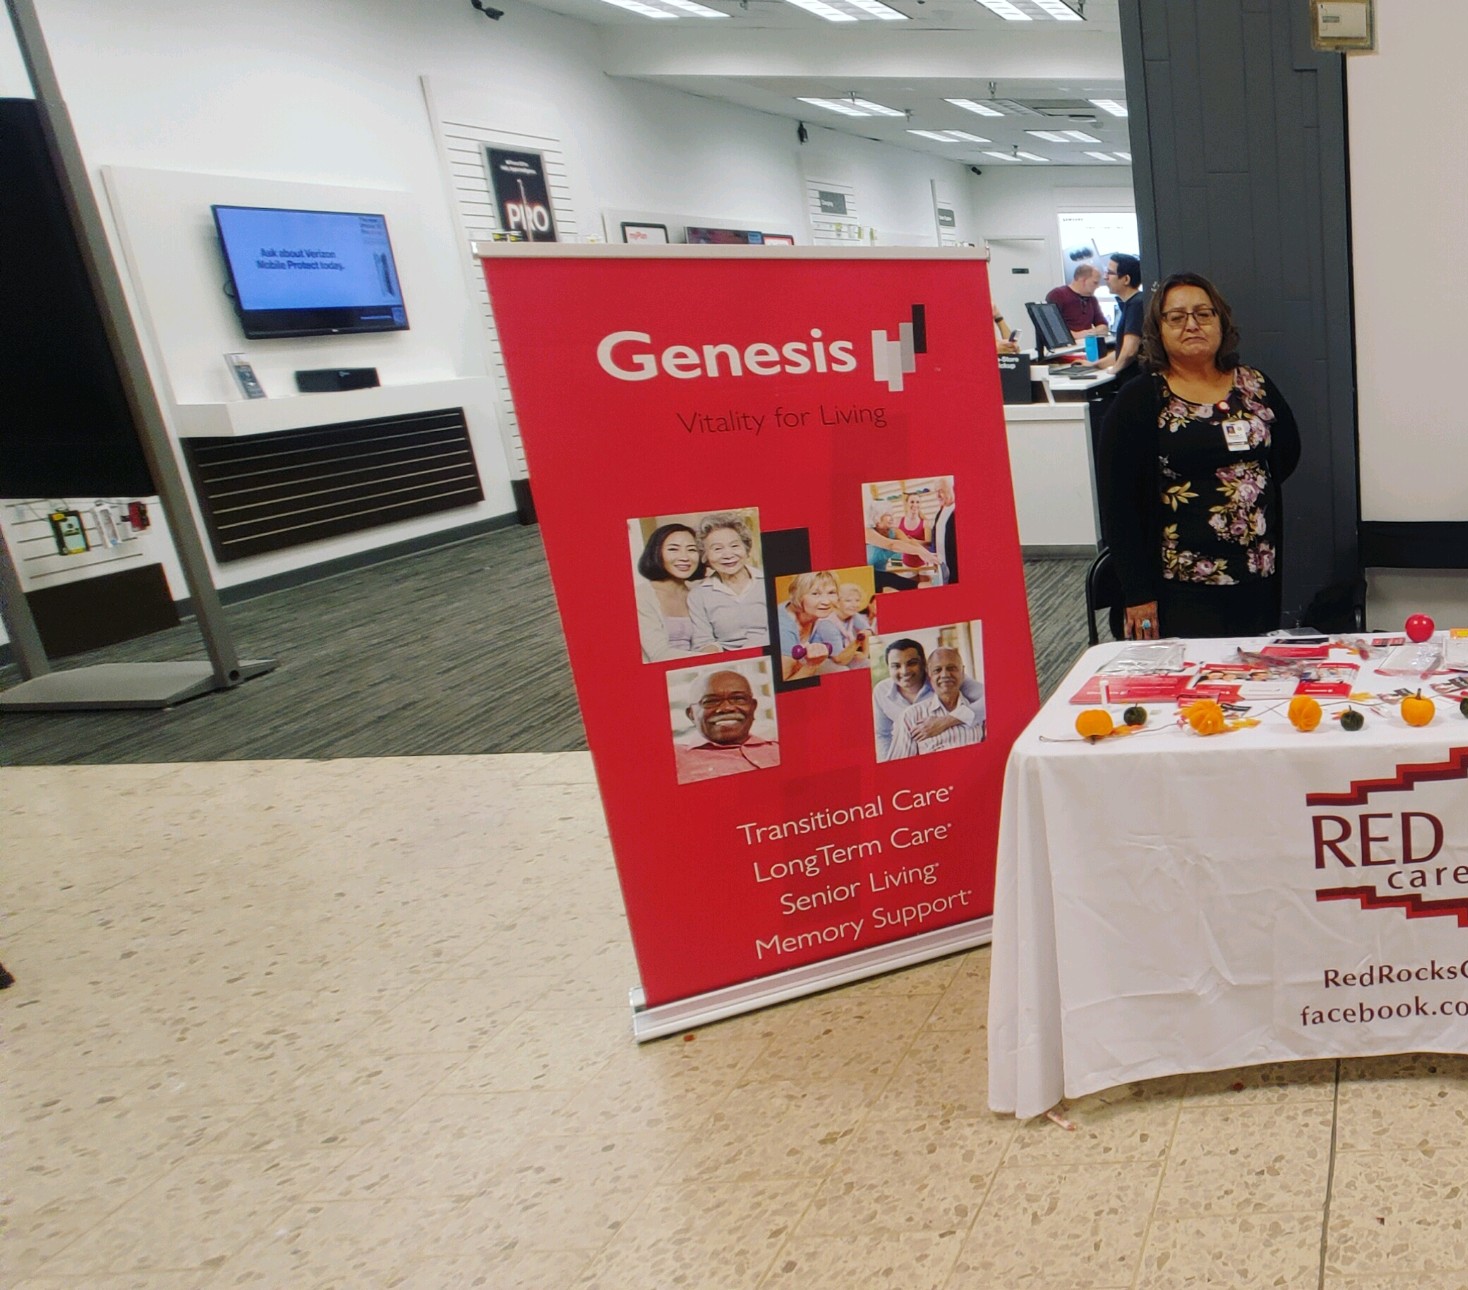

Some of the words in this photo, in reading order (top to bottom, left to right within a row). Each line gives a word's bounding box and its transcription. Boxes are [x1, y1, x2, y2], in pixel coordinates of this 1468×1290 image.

[596, 327, 858, 382] Genesis
[676, 410, 766, 436] Vitality
[774, 406, 811, 430] for
[819, 403, 888, 430] Living
[736, 795, 884, 845] Transitional
[1311, 810, 1445, 870] RED
[780, 881, 861, 915] Senior
[755, 918, 865, 960] Memory
